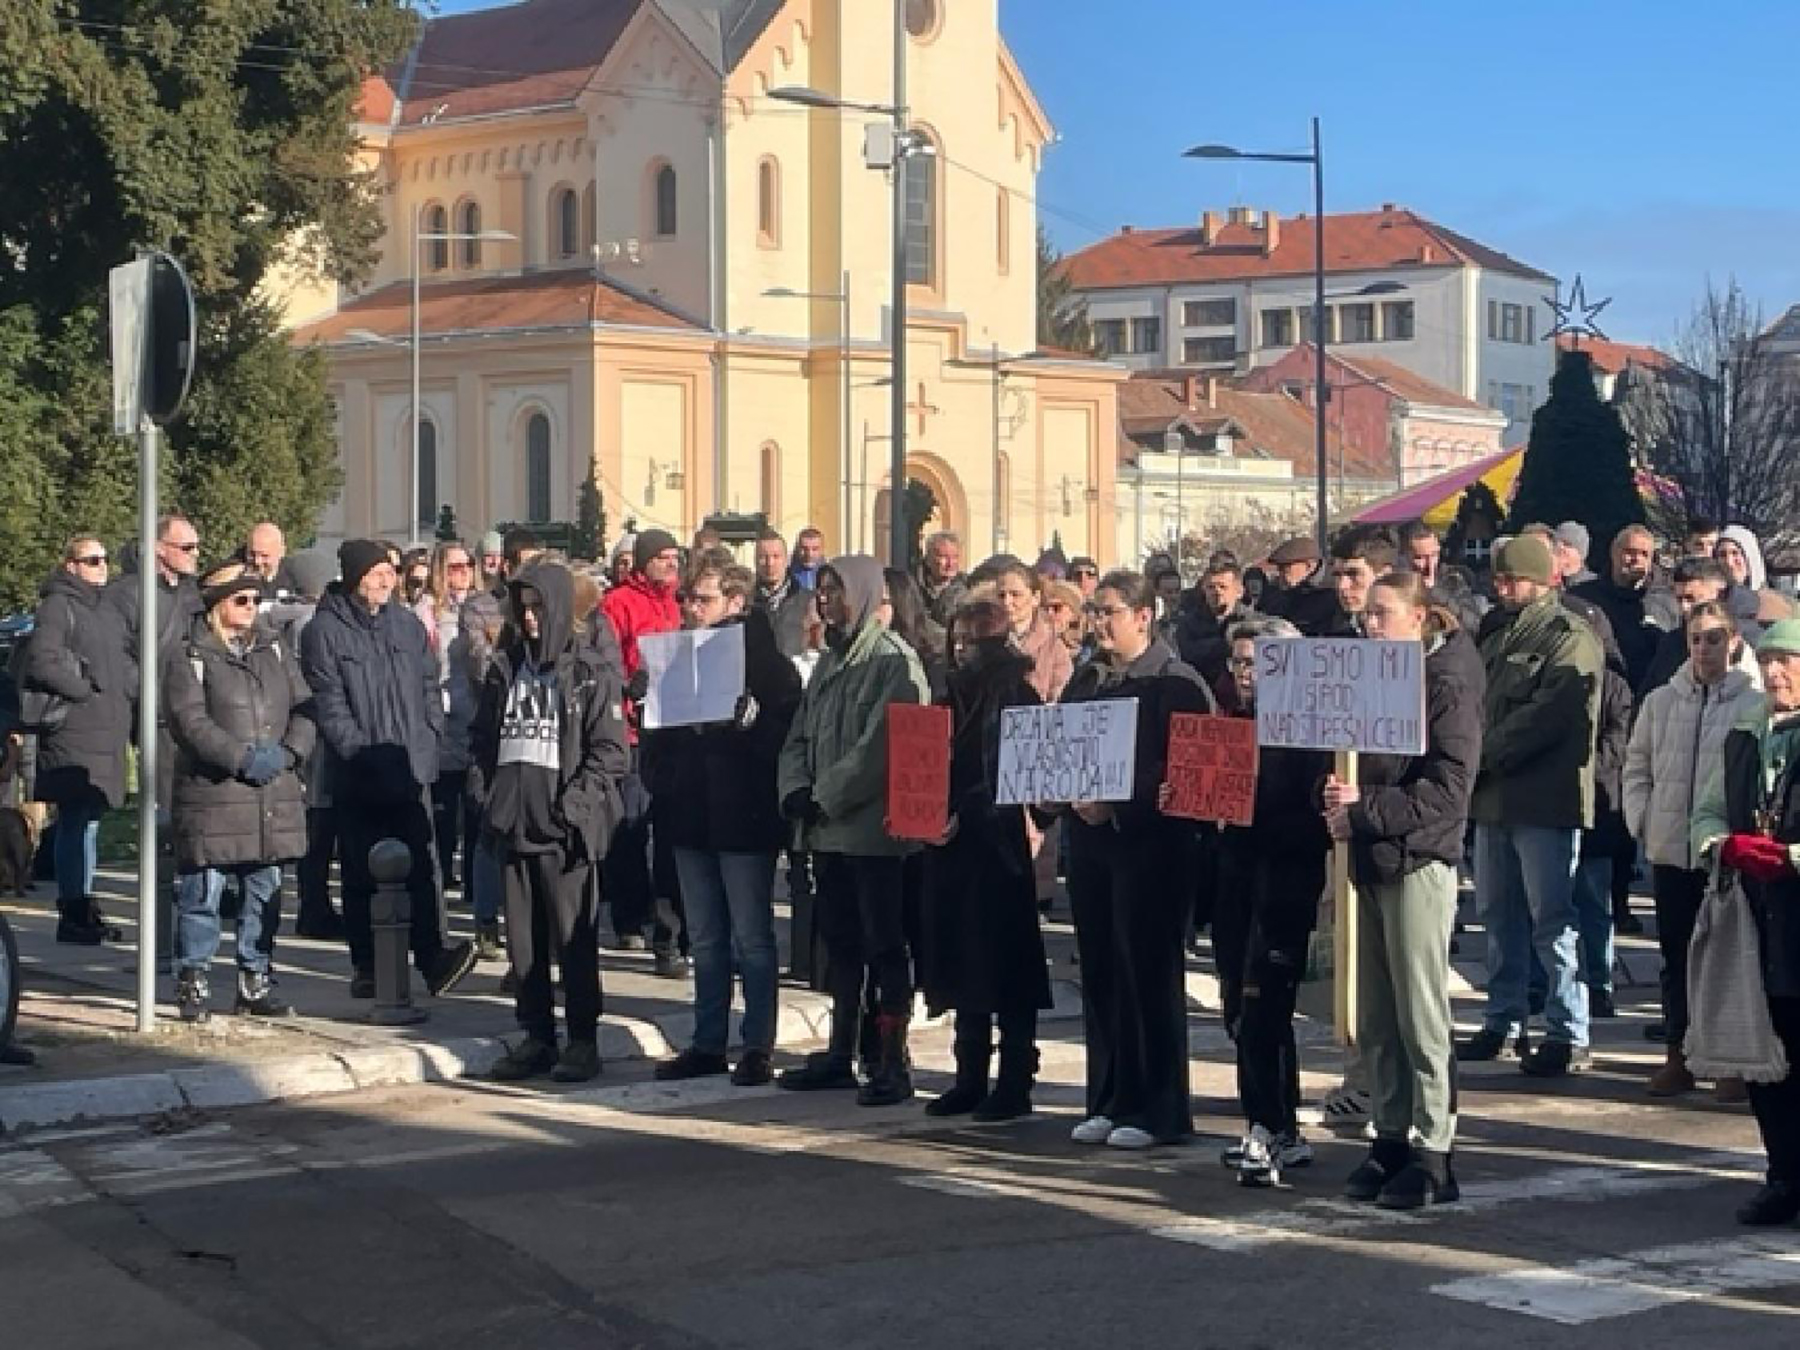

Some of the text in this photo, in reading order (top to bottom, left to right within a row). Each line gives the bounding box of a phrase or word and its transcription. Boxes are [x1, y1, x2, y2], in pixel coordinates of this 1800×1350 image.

[1262, 643, 1410, 681] SVI SMO MI
[1082, 704, 1111, 735] JE
